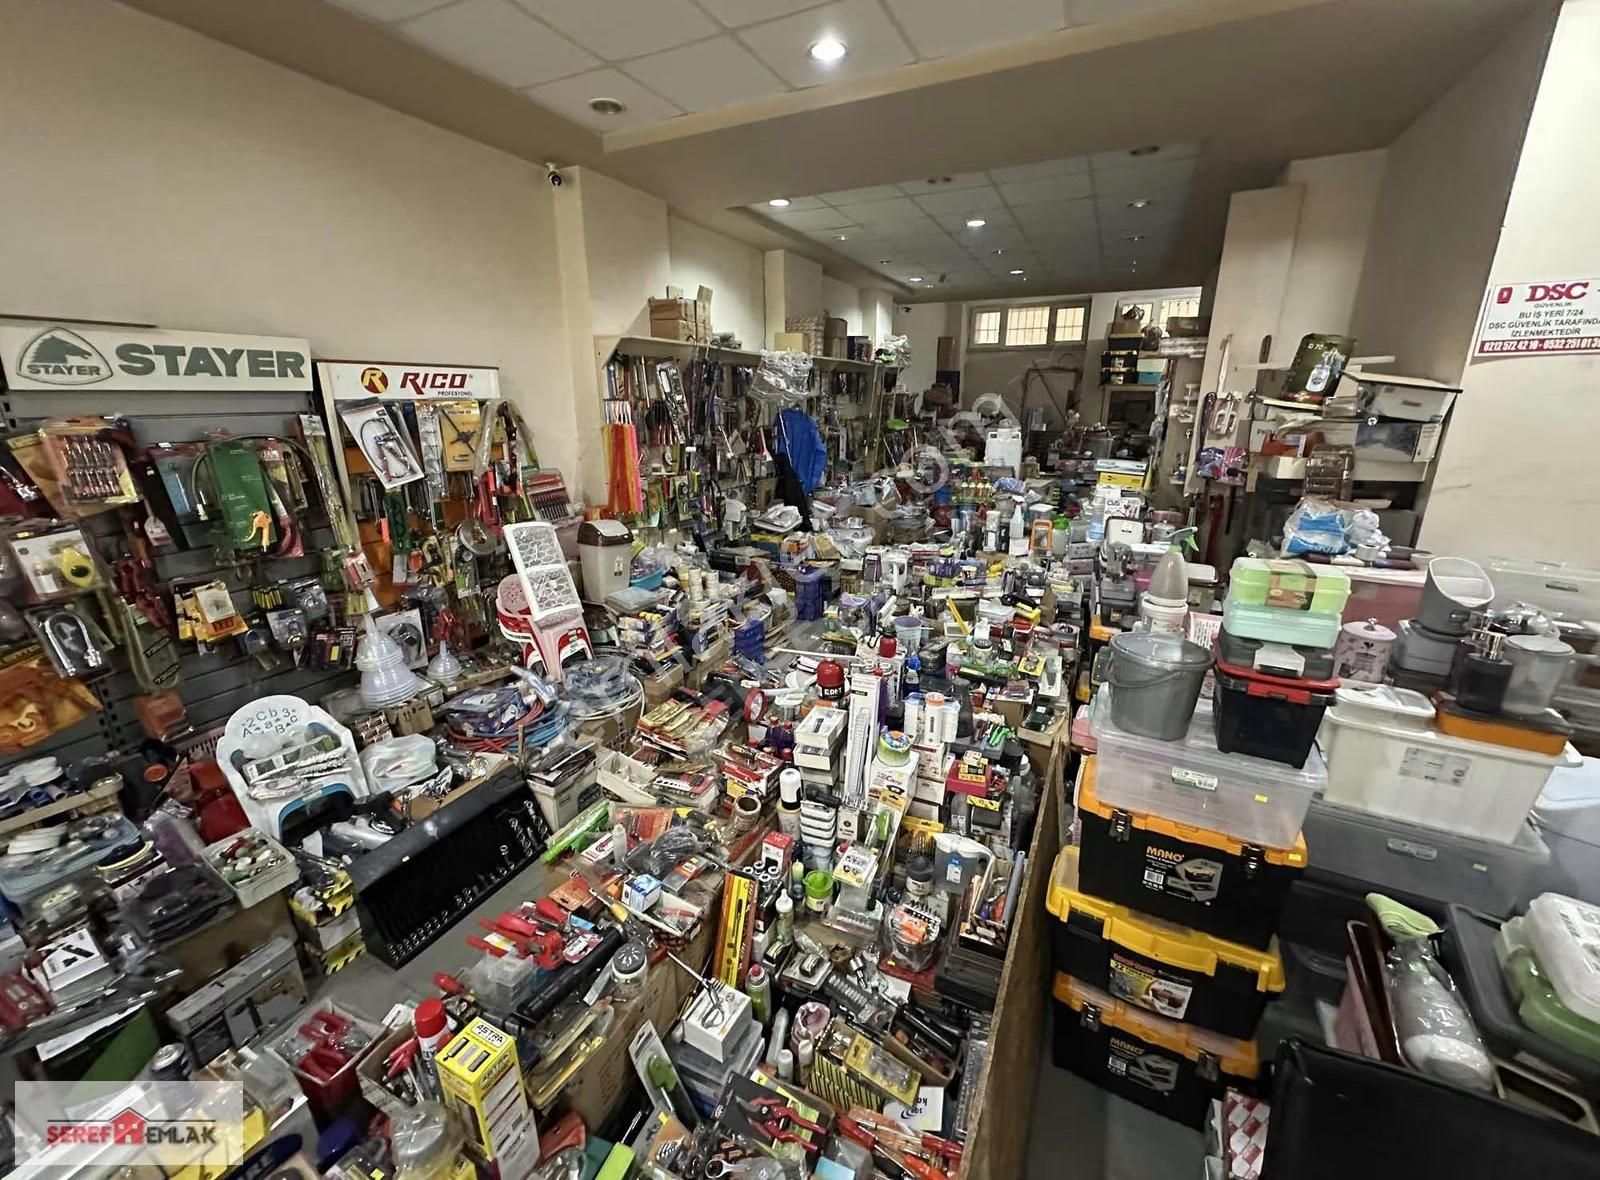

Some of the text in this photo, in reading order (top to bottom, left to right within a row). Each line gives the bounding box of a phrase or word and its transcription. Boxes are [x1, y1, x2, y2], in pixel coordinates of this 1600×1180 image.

[1525, 282, 1589, 302] DSC
[1519, 311, 1533, 319] BU
[1544, 308, 1565, 318] YERİ
[1566, 309, 1584, 317] 7/24
[1488, 322, 1506, 330] DSC
[1508, 319, 1551, 329] GÜVENLİK
[1511, 328, 1581, 338] İZLENMEKTEDİR
[1484, 341, 1502, 351] 0212
[115, 343, 306, 378] STAYER
[27, 363, 101, 376] STAYER
[400, 372, 467, 395] RICO
[1146, 846, 1182, 862] MANO
[477, 1024, 503, 1043] ASTRA
